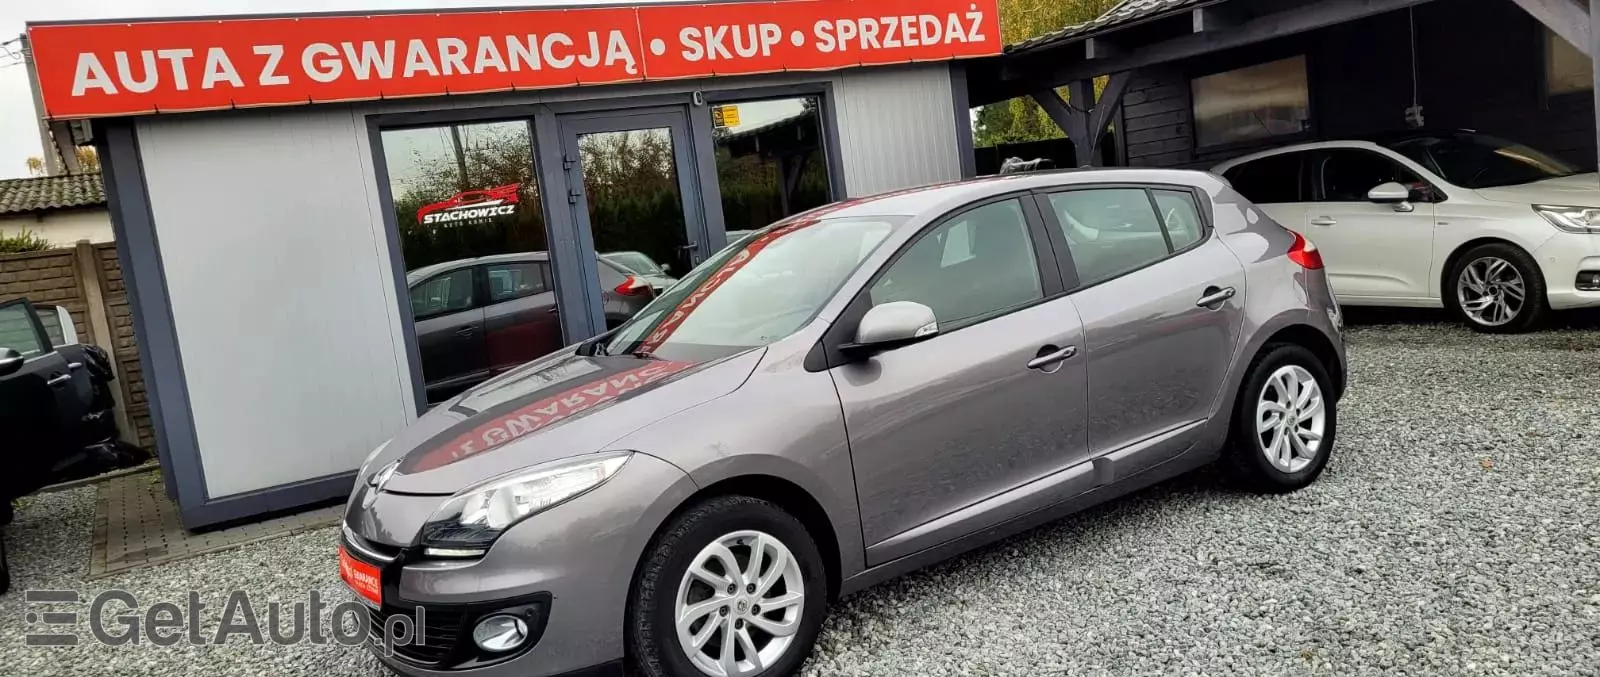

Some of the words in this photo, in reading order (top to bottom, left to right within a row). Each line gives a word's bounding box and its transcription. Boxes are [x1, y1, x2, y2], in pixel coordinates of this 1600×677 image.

[71, 48, 245, 97] AUTA
[252, 44, 290, 86] Z
[301, 29, 639, 83] GWARANCJĄ
[679, 23, 783, 62] SKUP
[813, 2, 986, 53] SPRZEDAŻ
[423, 204, 515, 224] STACHOWICZ
